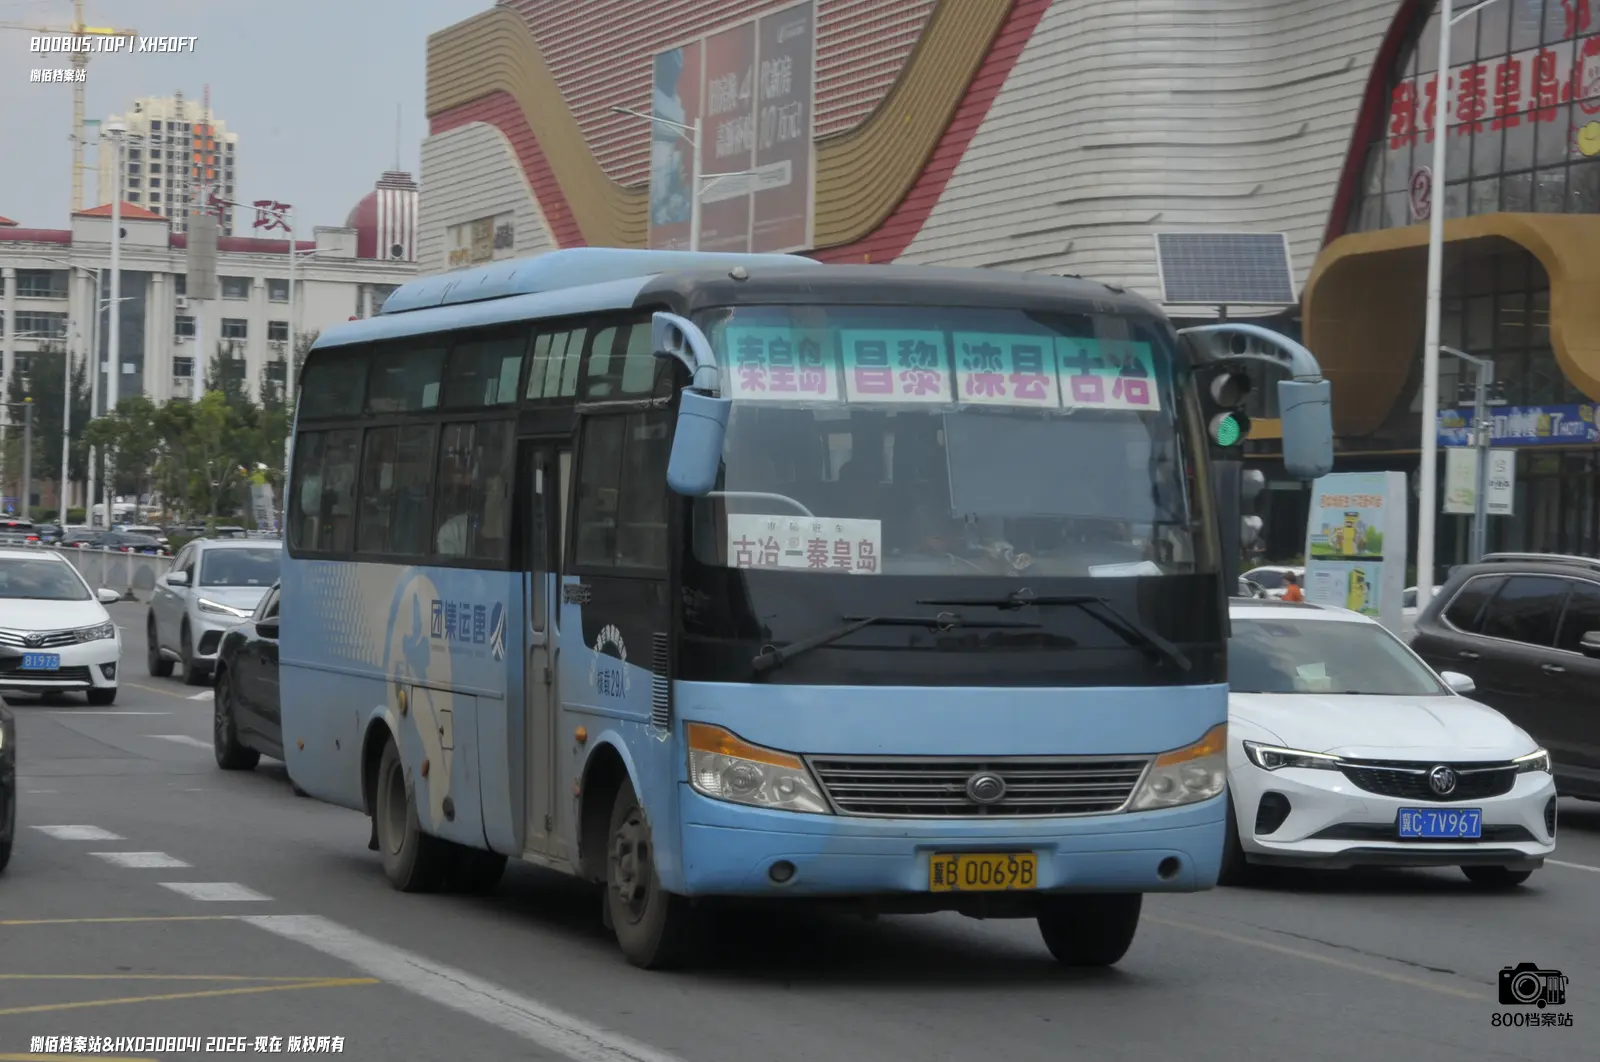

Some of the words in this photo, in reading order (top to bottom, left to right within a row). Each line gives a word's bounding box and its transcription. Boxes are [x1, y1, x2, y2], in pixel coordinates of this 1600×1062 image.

[737, 334, 827, 394] 秦皇岛
[853, 338, 941, 395] 昌黎
[962, 341, 1050, 399] 滦县
[1063, 348, 1150, 404] 古冶
